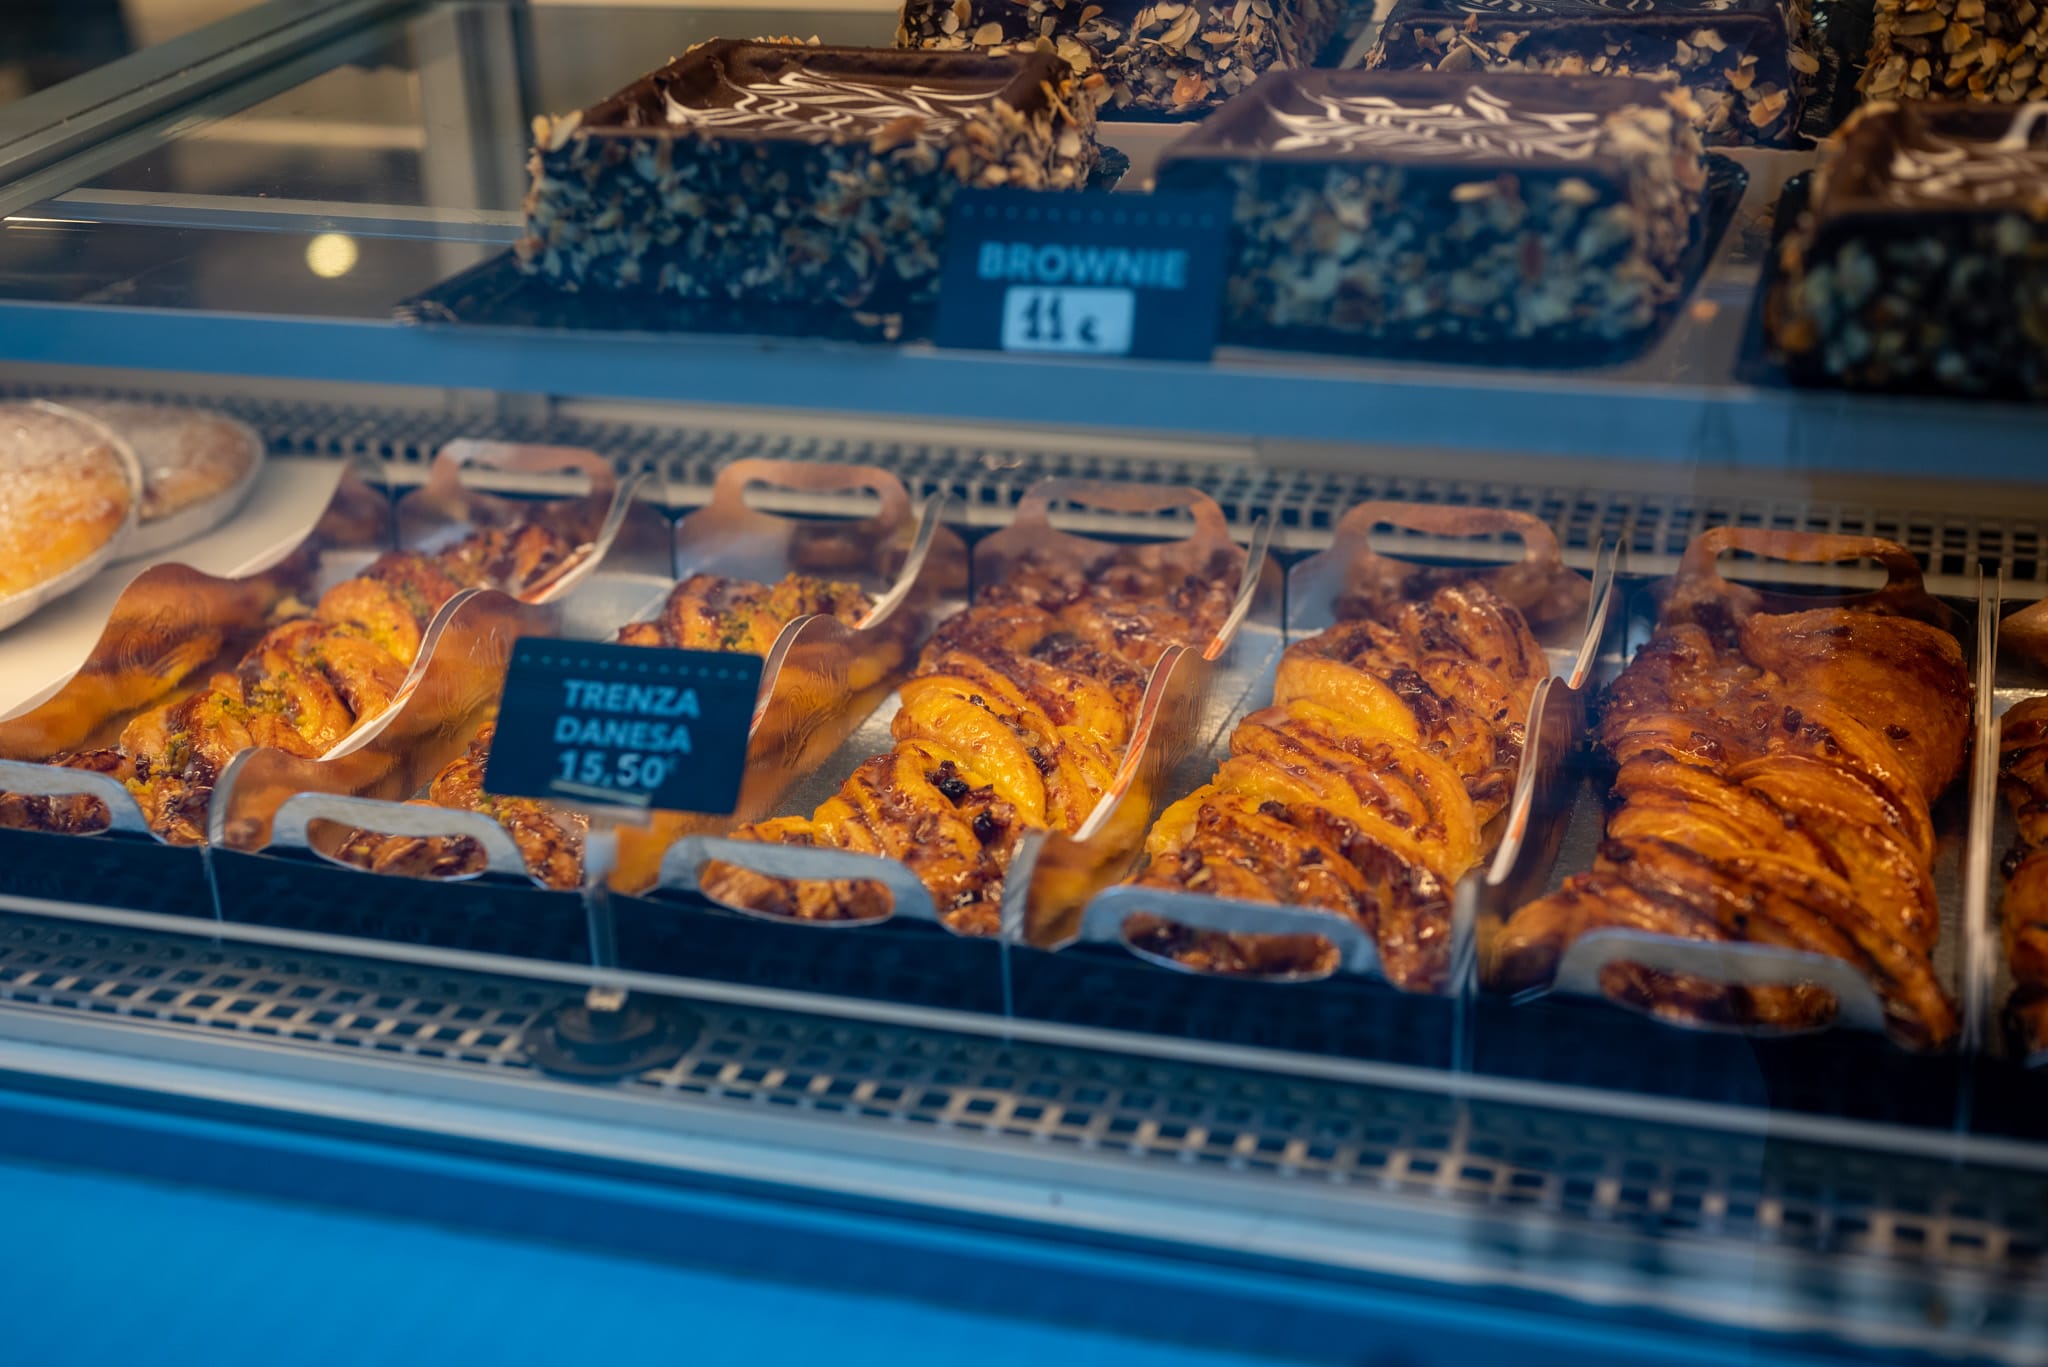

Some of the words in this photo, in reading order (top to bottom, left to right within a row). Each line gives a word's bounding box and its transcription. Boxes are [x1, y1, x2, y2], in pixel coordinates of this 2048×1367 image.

[978, 240, 1186, 288] BROWNIE
[1023, 293, 1062, 342] 11
[563, 679, 699, 718] TRENZA
[554, 715, 691, 753] DANESA
